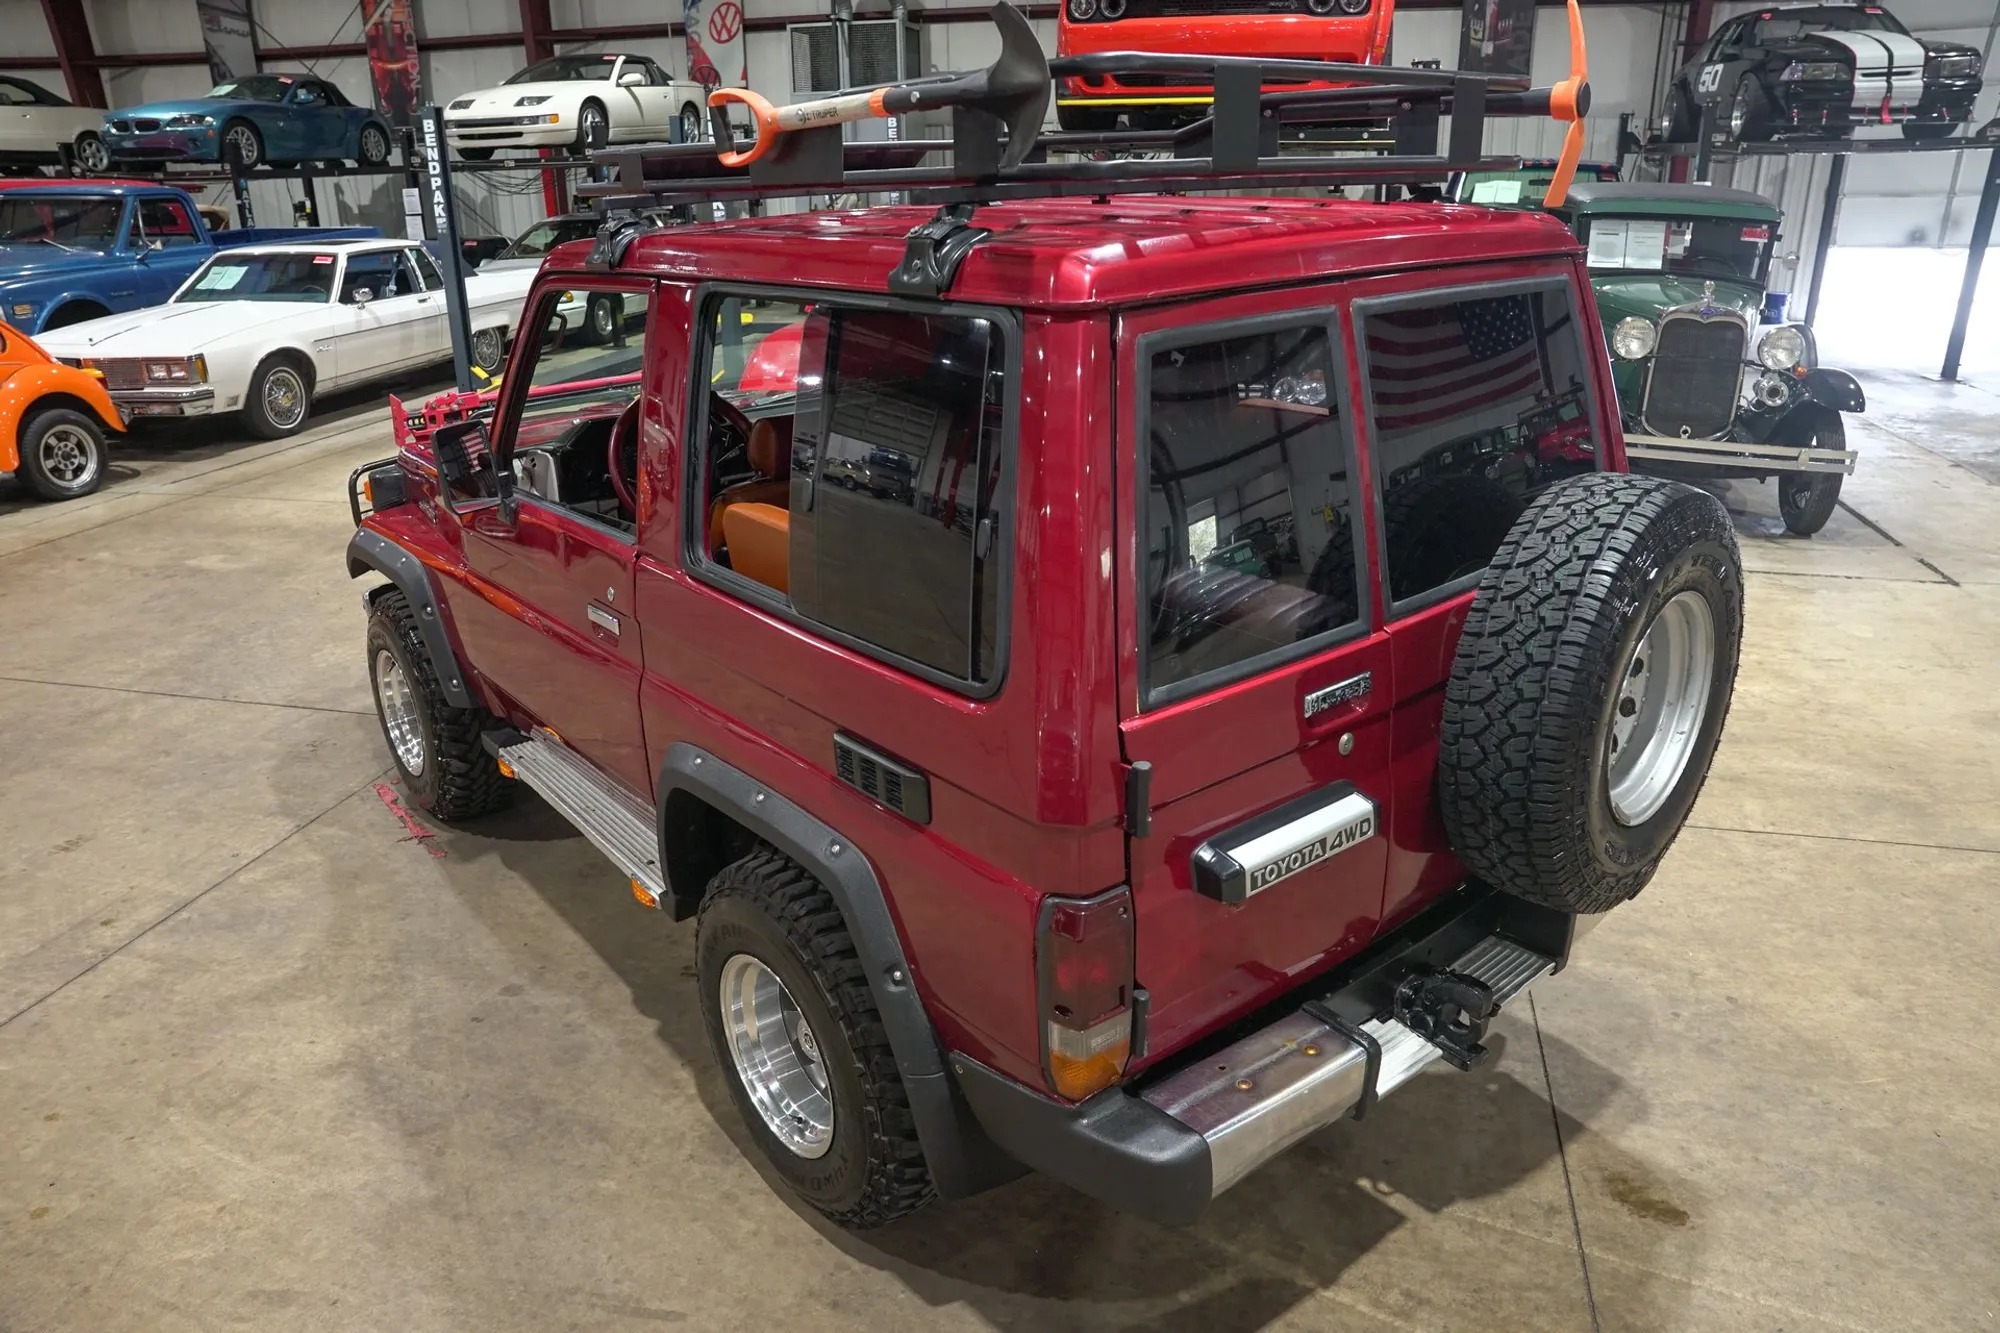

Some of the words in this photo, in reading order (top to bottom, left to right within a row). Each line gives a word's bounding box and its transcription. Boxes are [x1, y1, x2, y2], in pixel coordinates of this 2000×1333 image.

[1698, 63, 1724, 93] 50
[422, 118, 446, 217] BENDPAK
[242, 190, 255, 227] ATLA
[1253, 841, 1324, 888] TOYOTA
[1329, 818, 1372, 852] 4WD
